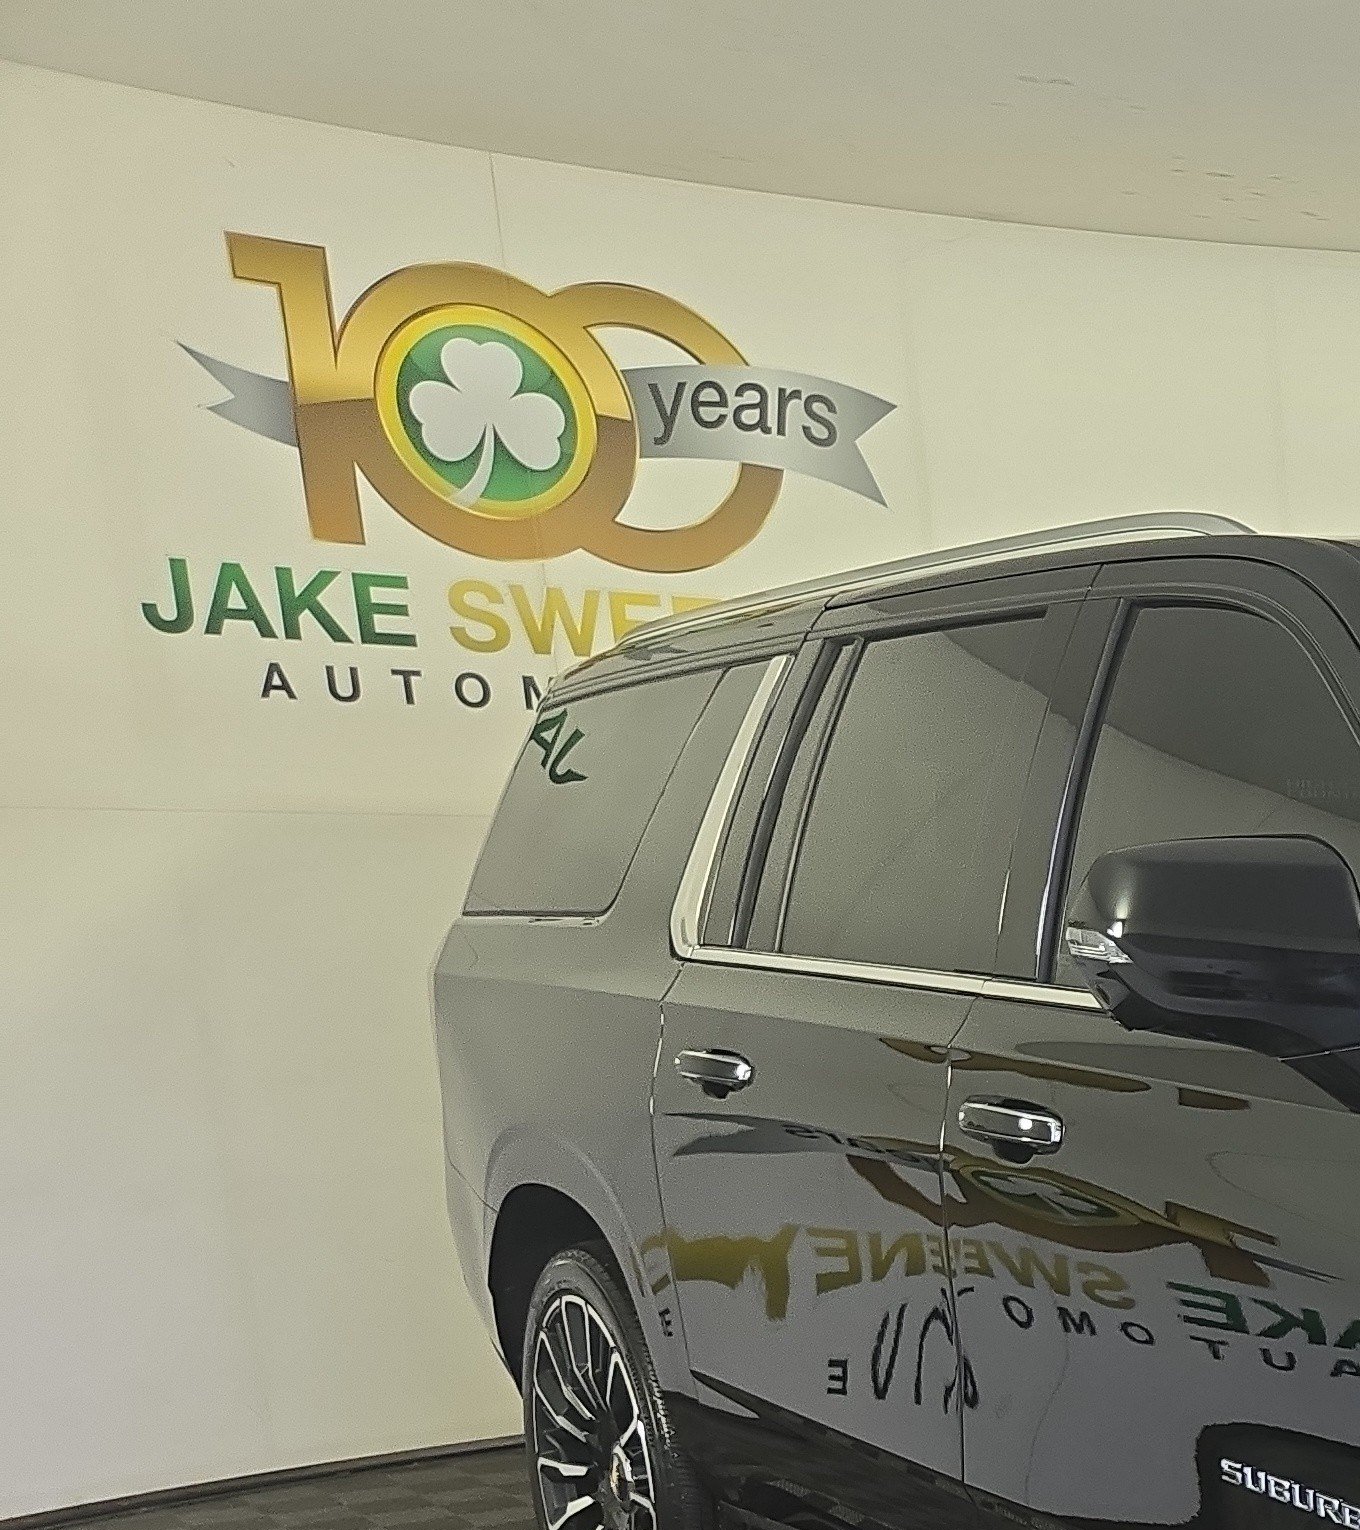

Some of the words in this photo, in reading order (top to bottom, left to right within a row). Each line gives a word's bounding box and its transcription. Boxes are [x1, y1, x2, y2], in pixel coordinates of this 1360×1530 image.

[648, 377, 839, 448] years
[141, 556, 420, 647] JAKE
[448, 578, 722, 658] SWE
